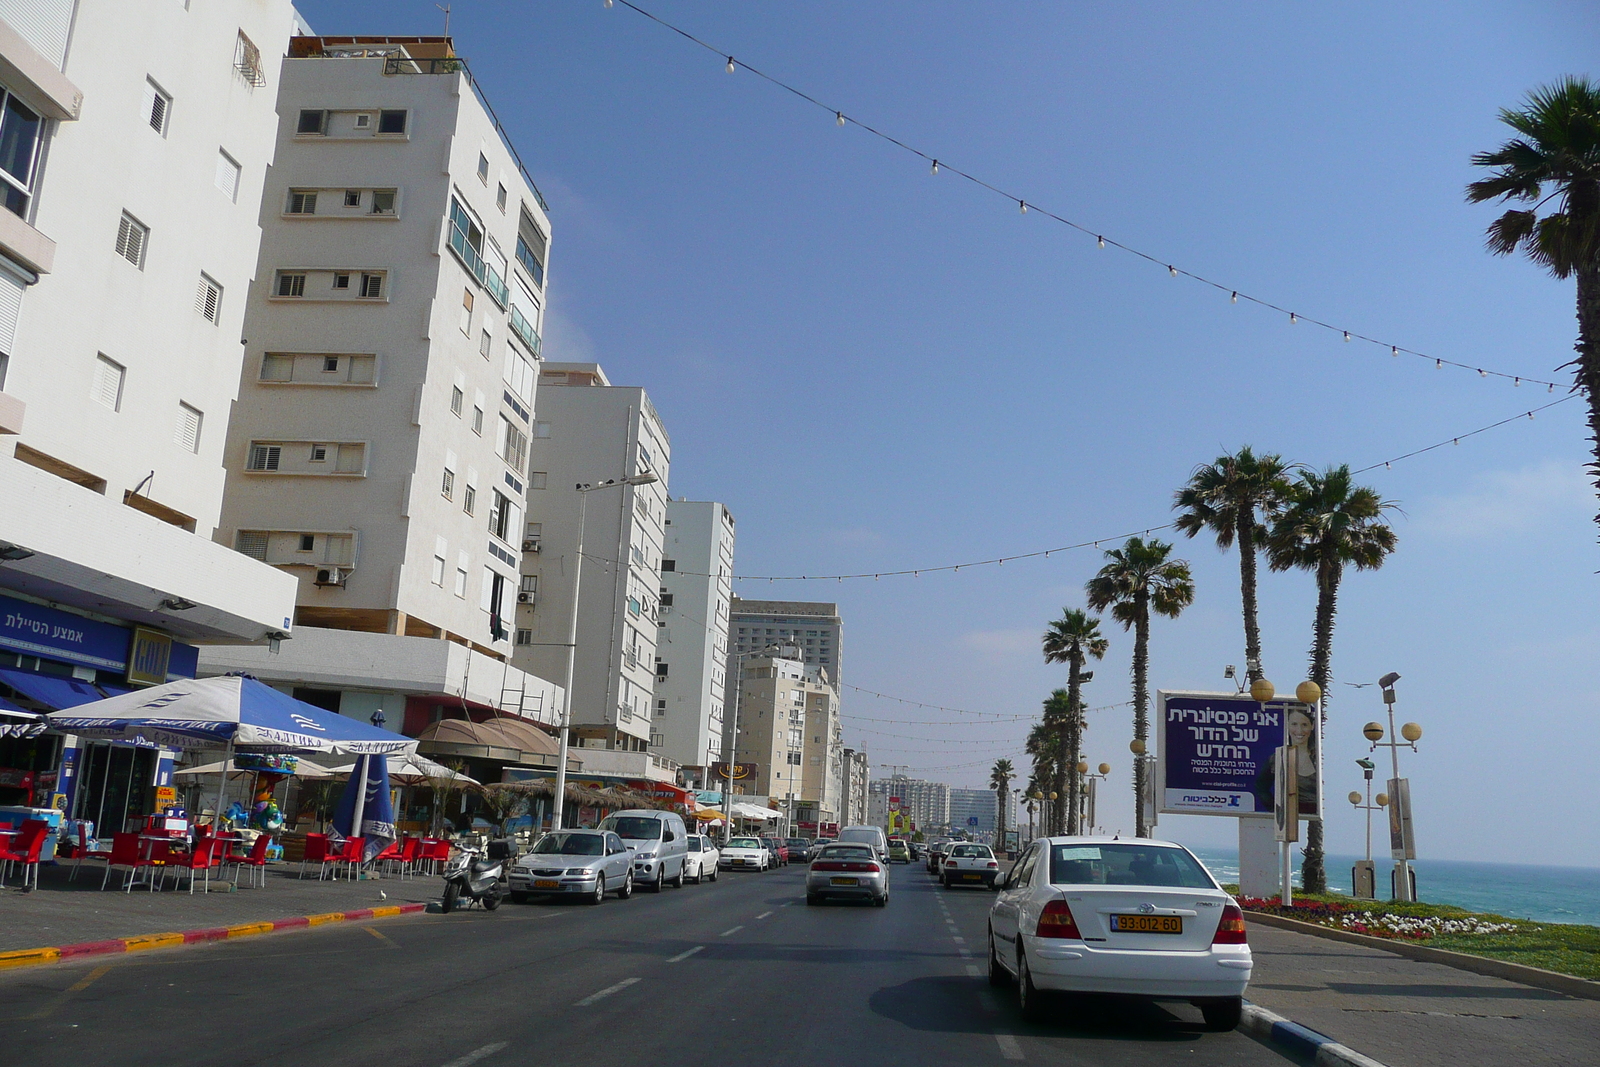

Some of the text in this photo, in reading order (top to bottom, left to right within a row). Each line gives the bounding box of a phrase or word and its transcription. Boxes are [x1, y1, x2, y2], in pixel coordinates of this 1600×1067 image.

[5, 612, 84, 643] אמצע הטיילת
[1253, 711, 1279, 727] אני
[1187, 725, 1259, 742] של הדור
[1196, 743, 1250, 759] החדש
